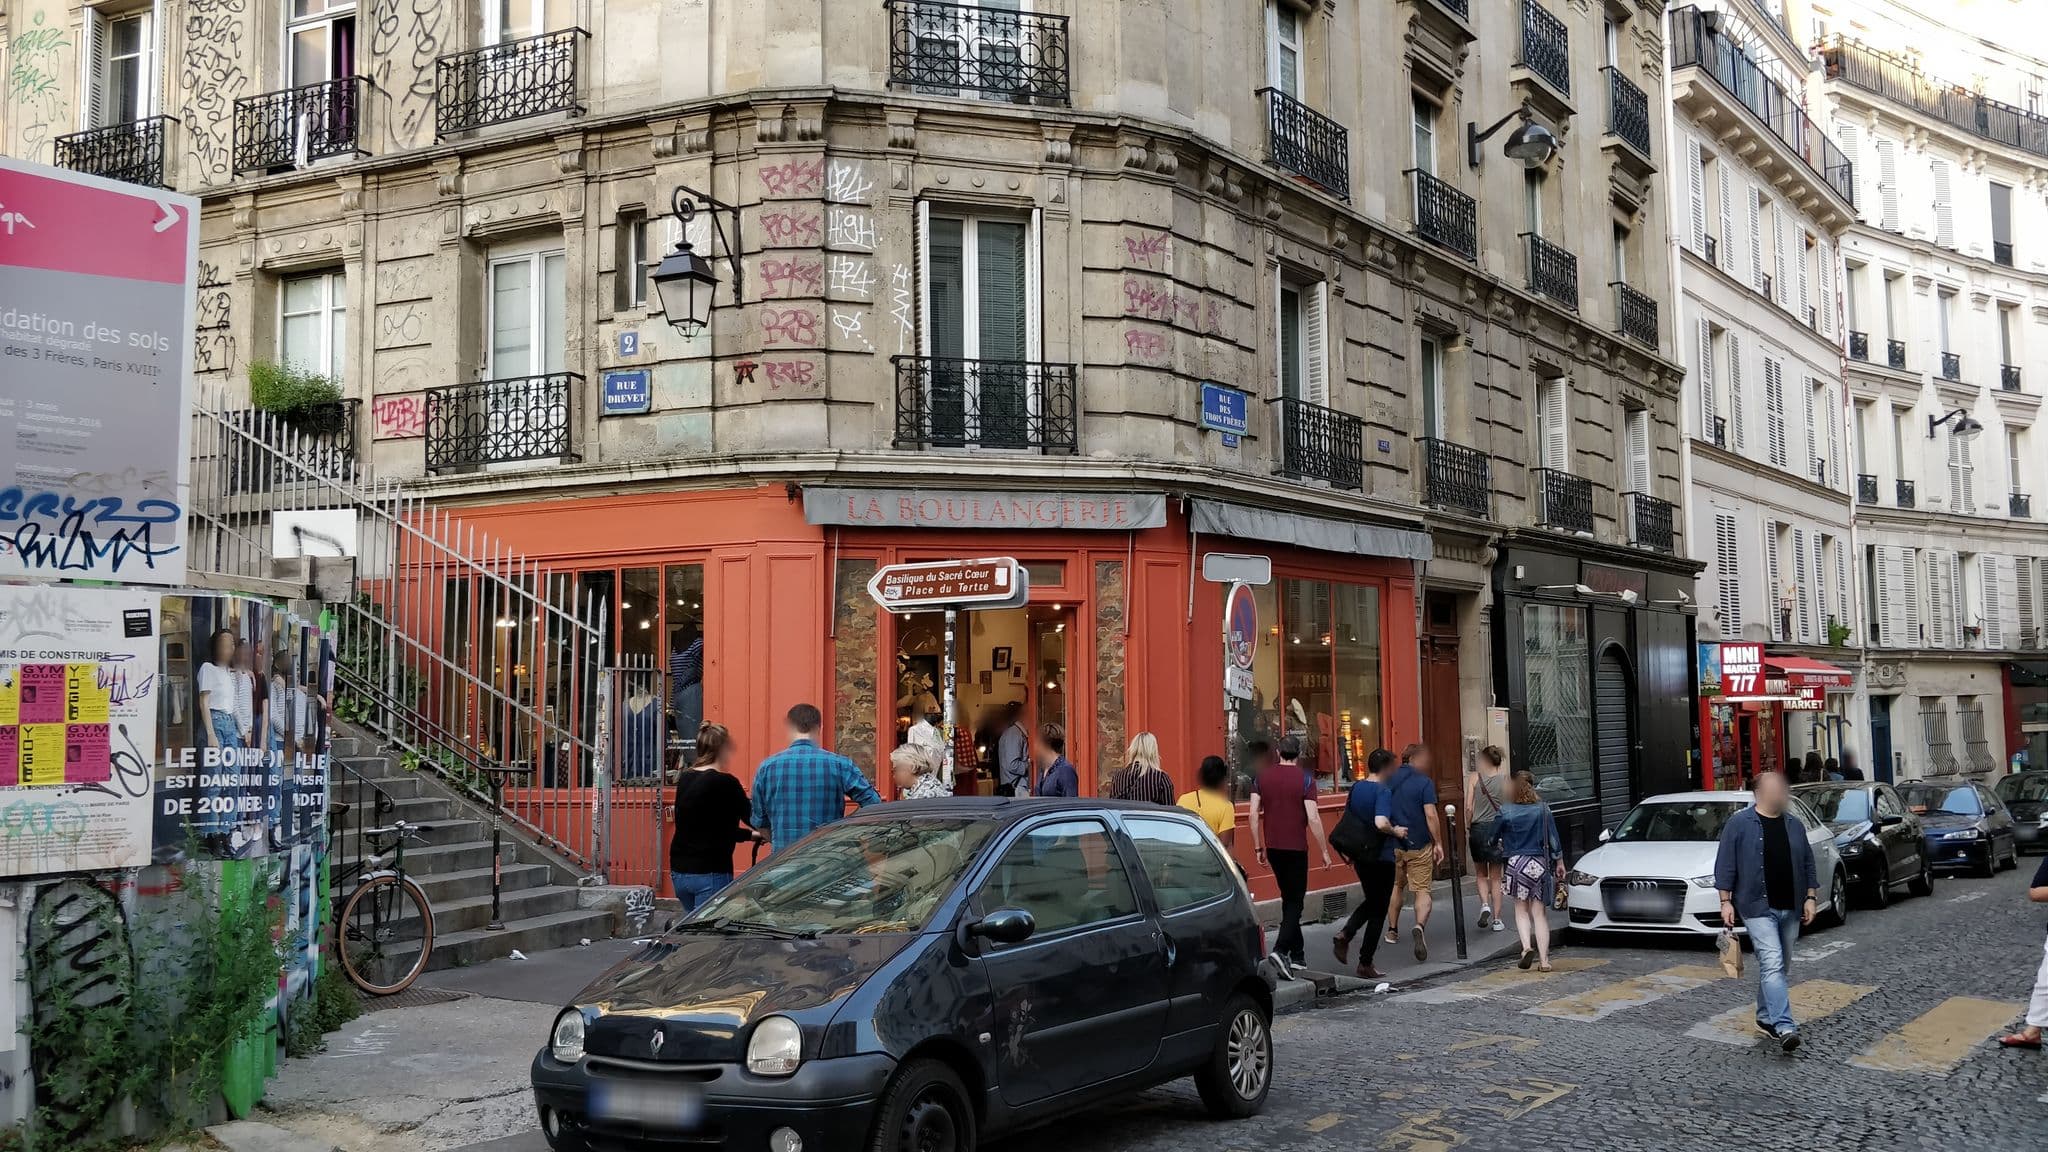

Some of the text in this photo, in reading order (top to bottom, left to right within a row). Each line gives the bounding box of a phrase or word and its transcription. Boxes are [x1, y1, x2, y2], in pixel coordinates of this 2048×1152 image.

[83, 321, 121, 344] des
[128, 331, 169, 351] sols
[624, 335, 634, 352] 2
[5, 345, 28, 358] des
[32, 347, 41, 359] 3
[93, 357, 122, 372] Paris
[616, 380, 637, 390] RUE
[607, 393, 646, 404] DREVET
[1218, 394, 1232, 405] RUE
[1219, 404, 1231, 415] DES
[1205, 411, 1222, 423] TROIS
[847, 496, 1130, 524] LA BOULANGERIE
[886, 569, 990, 585] Basilique du Sacré Cœur
[905, 585, 934, 596] Place
[939, 583, 952, 593] du
[21, 650, 36, 660] DE
[39, 650, 111, 660] CONSTRUIRE
[1723, 646, 1759, 663] MINI
[23, 665, 65, 674] GYM
[1723, 663, 1761, 674] MARKET
[1729, 675, 1757, 692] 7/7
[1783, 700, 1824, 709] MARKET
[68, 724, 109, 733] GYM
[165, 747, 197, 768] LE
[165, 774, 196, 789] EST
[199, 773, 239, 788] DANS
[163, 797, 193, 815] DE
[197, 796, 235, 814] 200
